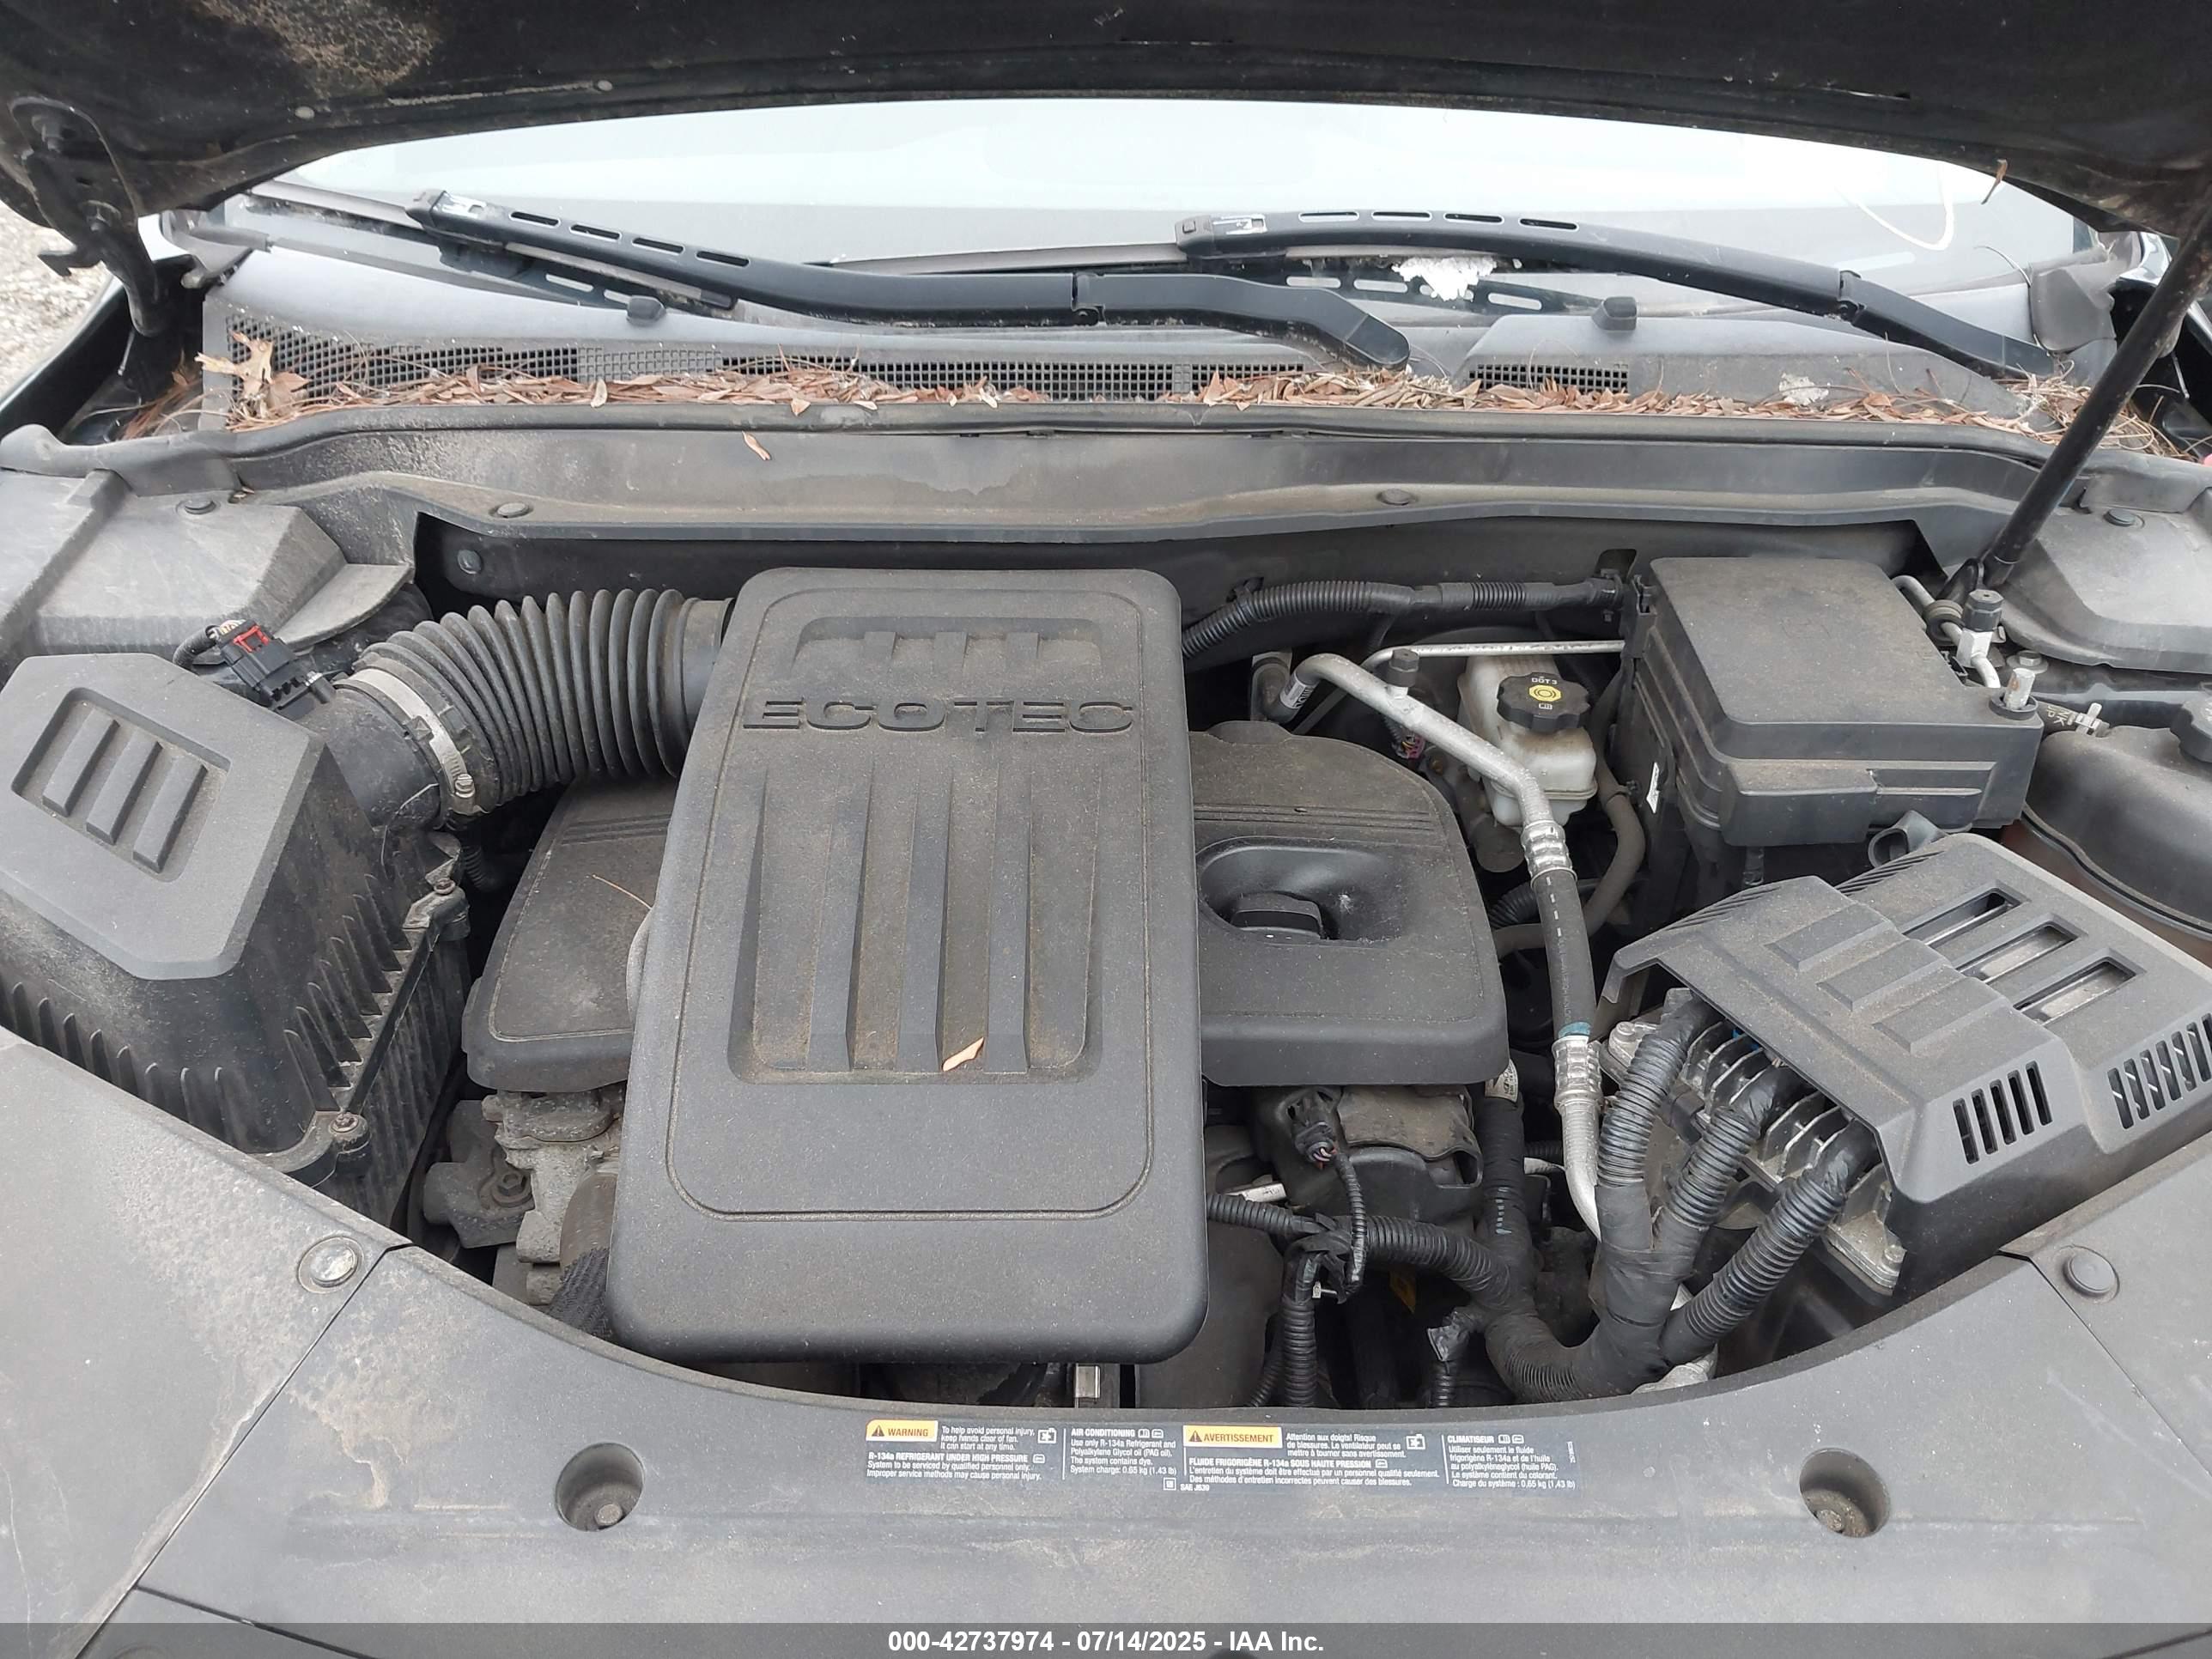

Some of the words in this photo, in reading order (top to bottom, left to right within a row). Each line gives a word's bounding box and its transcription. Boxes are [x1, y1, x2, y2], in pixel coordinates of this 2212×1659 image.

[743, 697, 1133, 732] ECOTEC
[888, 1428, 928, 1437] WARNING
[1204, 1434, 1273, 1443] AVERTISSEMENT
